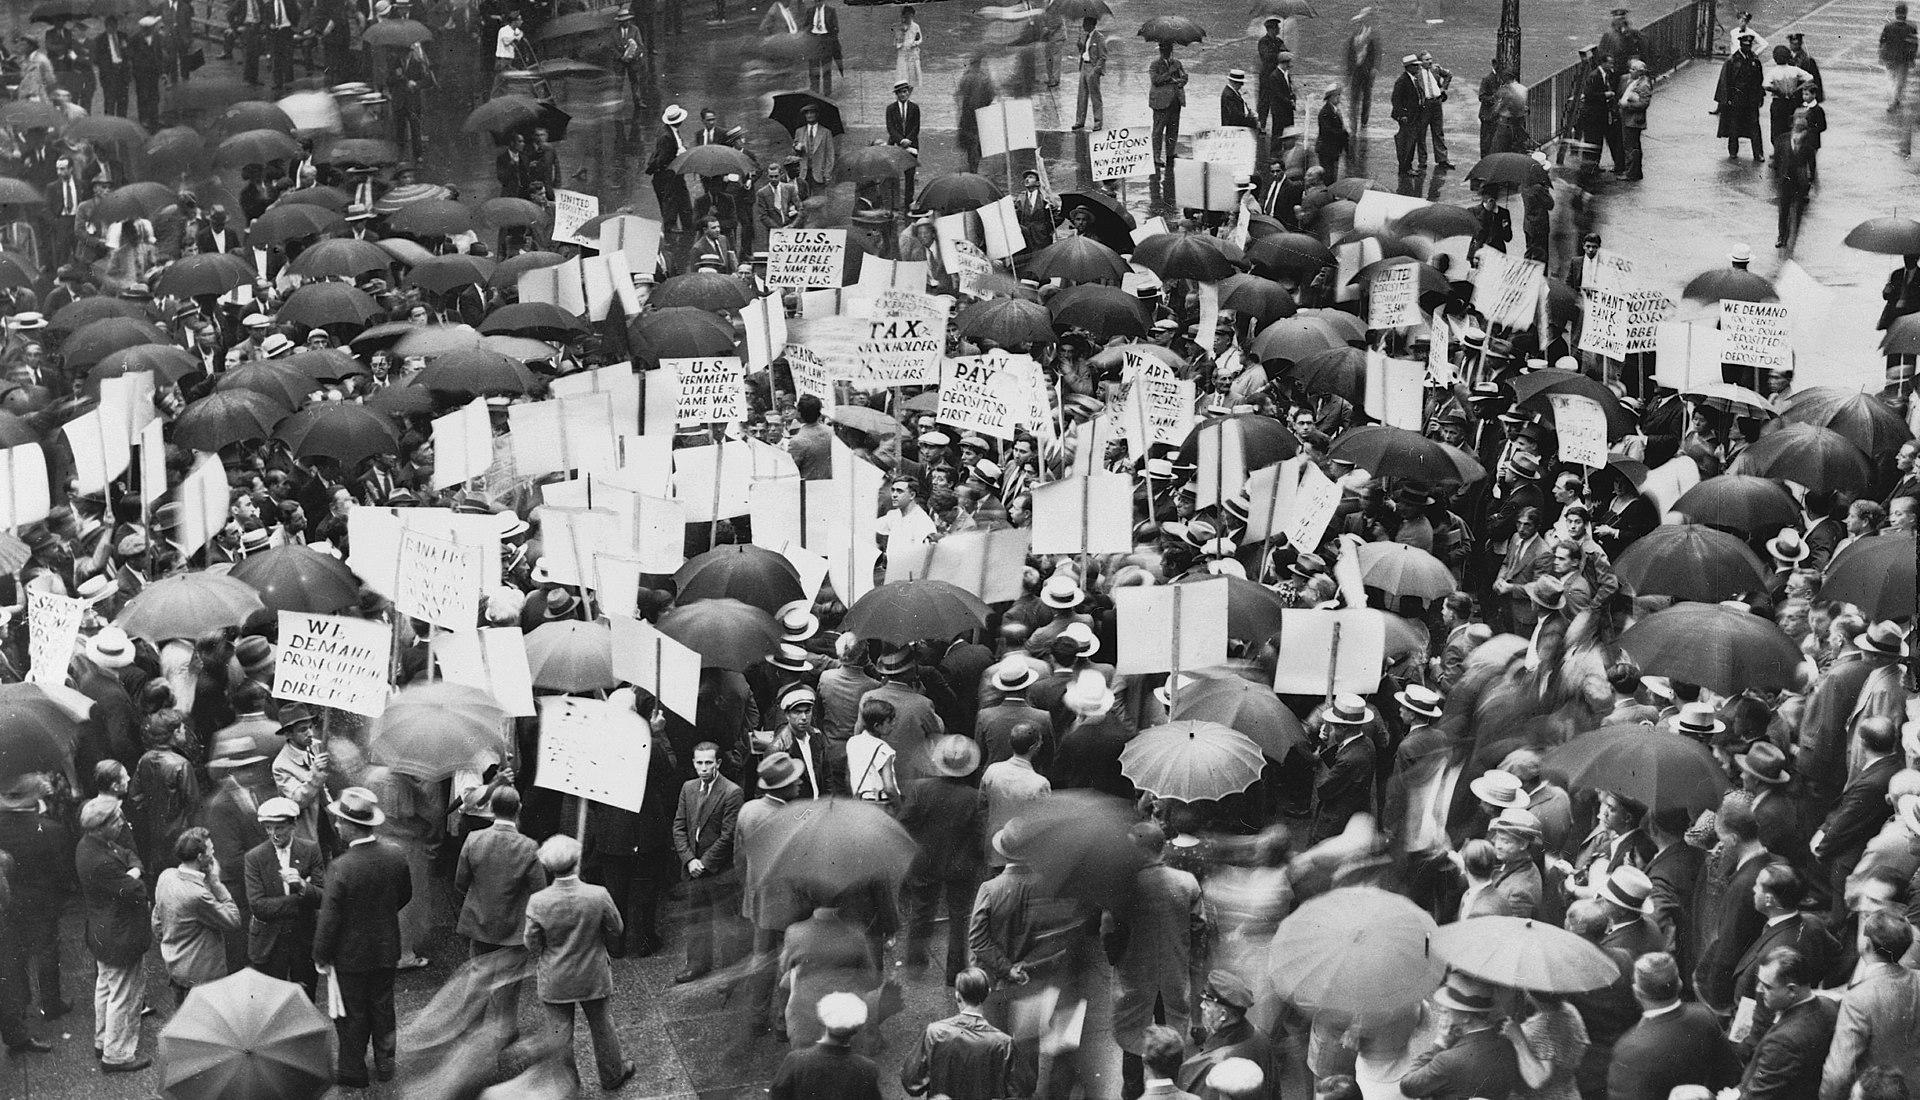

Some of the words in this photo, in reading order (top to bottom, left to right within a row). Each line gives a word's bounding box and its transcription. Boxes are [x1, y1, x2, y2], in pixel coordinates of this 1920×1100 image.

[1106, 128, 1130, 142] NO
[1093, 136, 1150, 152] EVICTIONS
[1107, 163, 1136, 176] RENT
[559, 193, 590, 208] UNITED
[794, 231, 830, 244] U.S.
[772, 244, 843, 253] GOVERNMENT
[785, 254, 832, 265] LIABLE
[783, 265, 808, 274] NAME
[811, 265, 834, 274] WAS
[807, 275, 831, 285] U.S.
[1601, 292, 1625, 312] WANT
[1724, 303, 1739, 313] WE
[1742, 304, 1789, 318] DEMAND
[869, 319, 923, 340] TAX
[1124, 351, 1144, 368] WE
[691, 360, 729, 374] U.S.
[953, 362, 997, 386] PAY
[679, 372, 739, 385] VERNMENT
[682, 384, 725, 396] LIABLE
[951, 381, 998, 399] SMALL
[712, 394, 736, 404] WAS
[712, 406, 739, 419] U.S.
[940, 407, 972, 422] FIRST
[977, 413, 1005, 428] FULL
